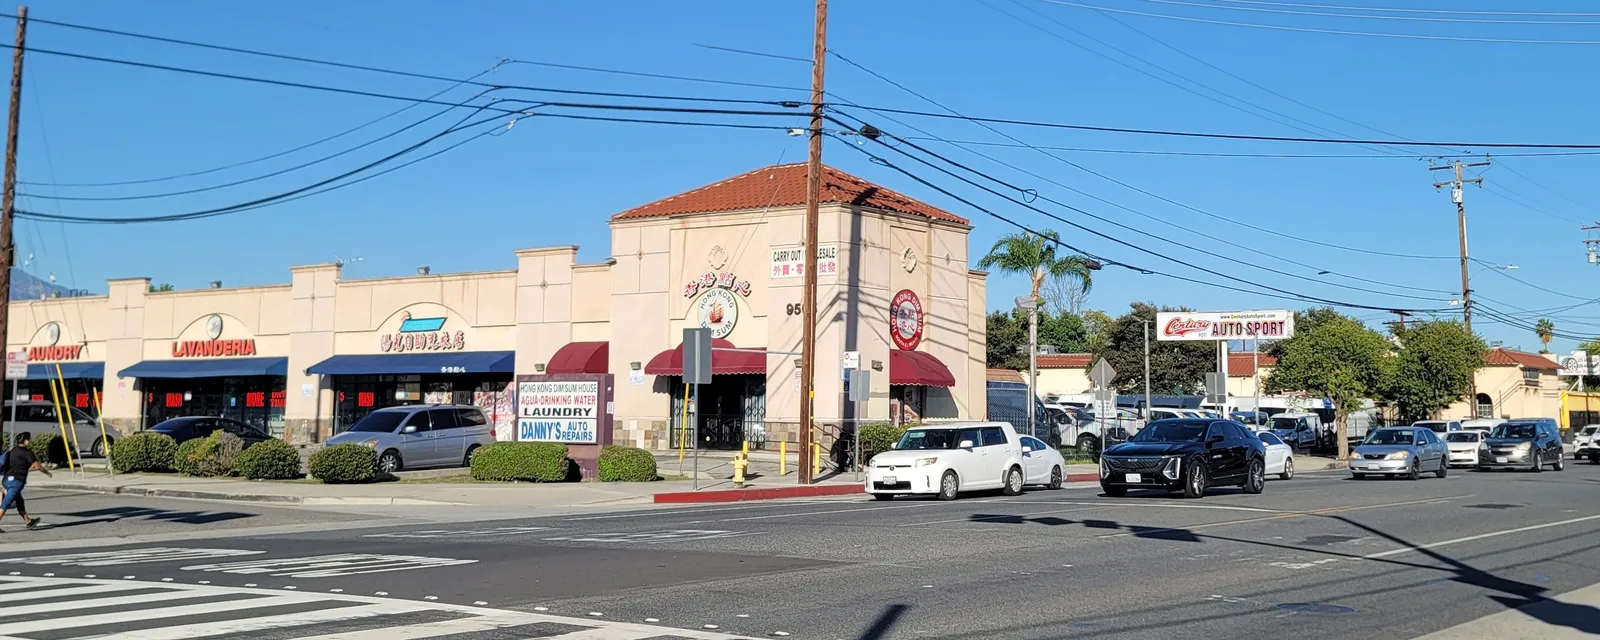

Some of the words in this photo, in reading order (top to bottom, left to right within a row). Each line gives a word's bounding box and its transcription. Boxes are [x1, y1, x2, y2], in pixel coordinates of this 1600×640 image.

[773, 251, 790, 262] CARRY
[791, 250, 801, 261] OUT
[700, 290, 717, 309] HONG
[718, 290, 735, 308] KONG
[716, 320, 733, 337] SUM
[1164, 316, 1212, 337] Century
[1212, 321, 1243, 336] AUTO
[1246, 320, 1285, 336] SPORT
[23, 344, 82, 361] AUNDRY
[172, 339, 257, 357] LAVANDERIA
[520, 384, 537, 393] HONG
[537, 383, 553, 393] KONG
[554, 383, 564, 393] DIM
[565, 383, 578, 393] SUM
[578, 383, 597, 393] HOUSE
[574, 395, 596, 405] WATER
[524, 407, 592, 416] LAUNDRY
[521, 421, 562, 440] DANNY'S
[567, 421, 588, 431] AUTO
[562, 431, 593, 440] REPAIRS
